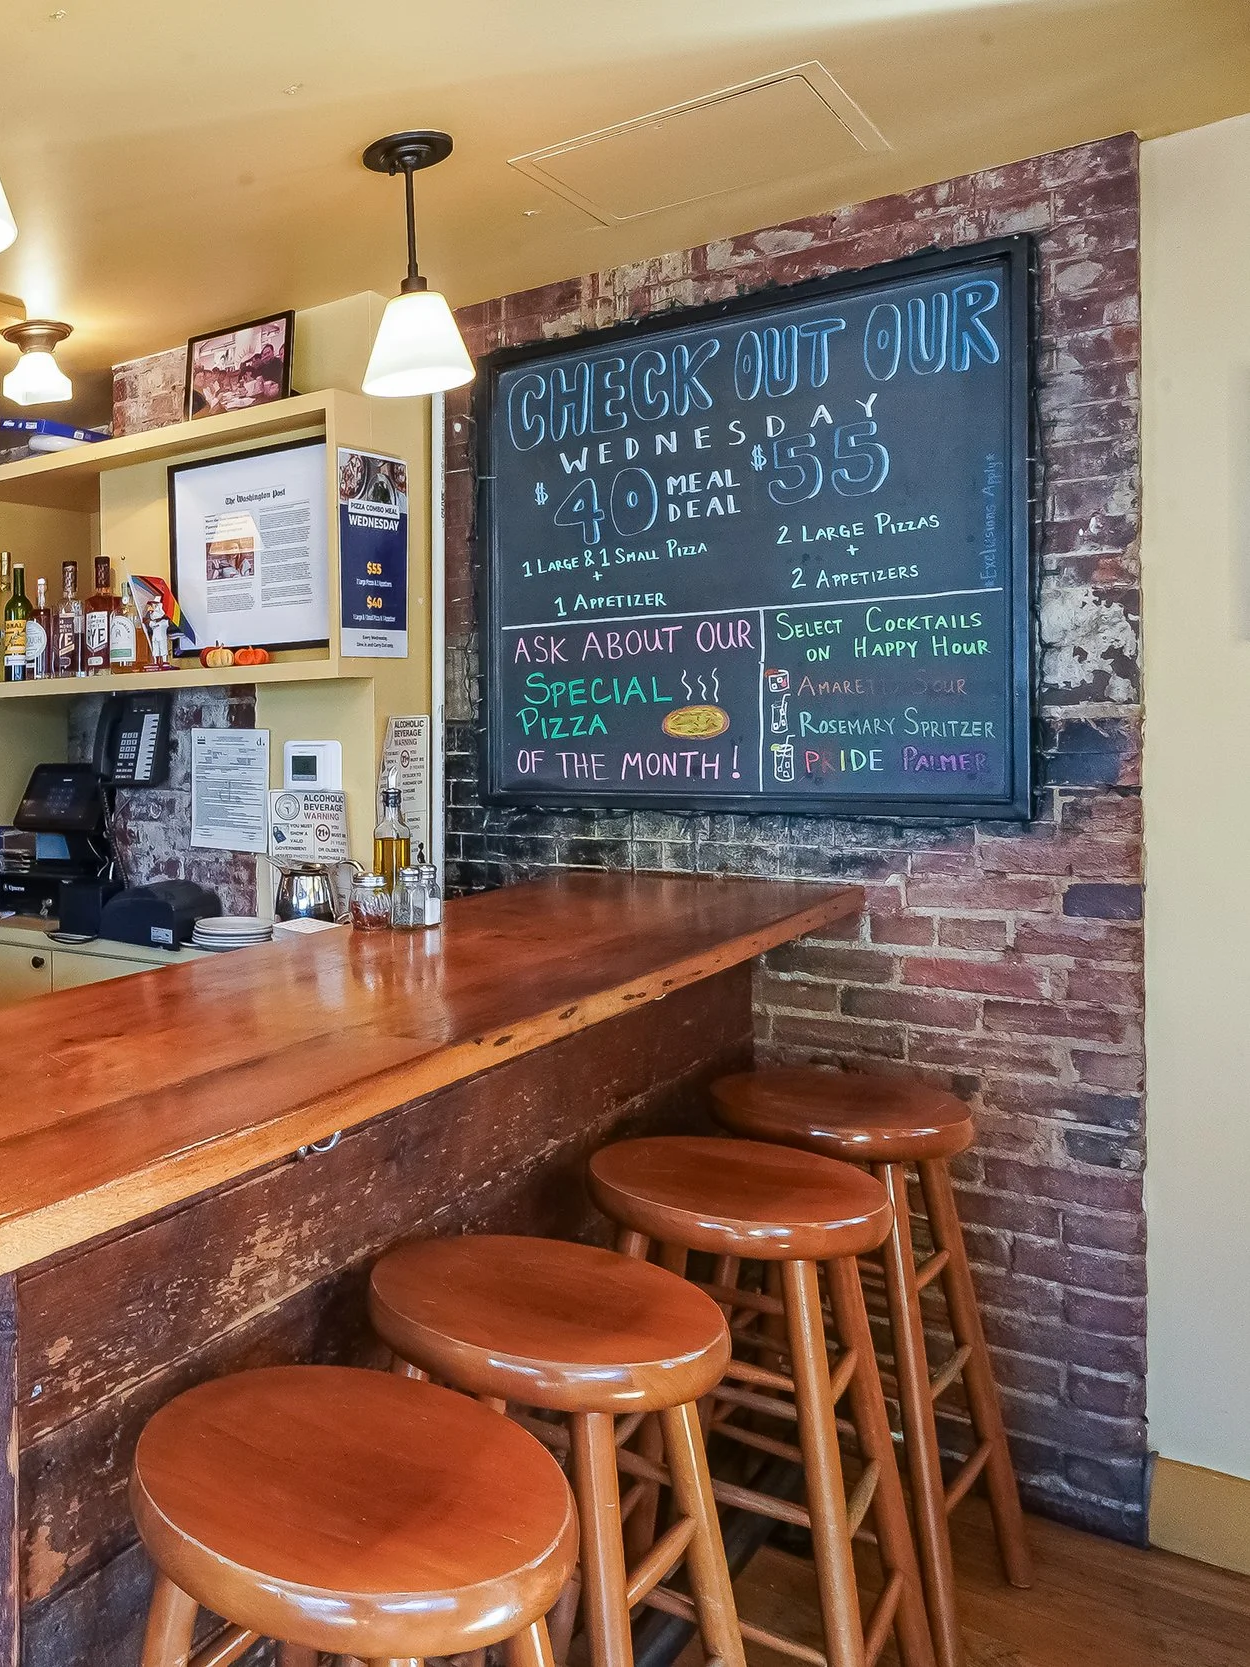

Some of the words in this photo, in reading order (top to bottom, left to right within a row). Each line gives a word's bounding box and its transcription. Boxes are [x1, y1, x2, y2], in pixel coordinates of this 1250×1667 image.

[508, 339, 720, 451] CHECK
[734, 318, 846, 401] OUT
[864, 280, 1000, 382] OUR
[559, 393, 878, 475] WEDNESDAY
[667, 469, 741, 496] MEAL
[225, 497, 235, 505] The
[236, 493, 271, 503] Washington
[272, 488, 286, 499] Post
[350, 501, 365, 511] PIZZA
[668, 494, 741, 522] DEAL
[348, 514, 400, 532] WEDNESDAY
[776, 525, 792, 544] 2
[584, 550, 595, 567] &
[600, 549, 610, 566] 1
[366, 561, 383, 575] $55
[791, 568, 806, 589] 2
[366, 595, 383, 609] $40
[554, 597, 567, 616] 1
[776, 612, 843, 641] SELECT
[865, 606, 982, 633] COCKTAILS
[514, 636, 569, 664] ASK
[582, 625, 682, 661] ABOUT
[696, 619, 755, 652] OUR
[854, 636, 918, 658] HAPPY
[931, 635, 991, 657] HOUR
[524, 672, 673, 708] SPECIAL
[394, 720, 425, 729] ALCOHOLIC
[516, 707, 608, 739] PIZZA
[800, 711, 896, 738] ROSEMARY
[903, 706, 996, 739] SPRITZER
[394, 729, 422, 738] BEVERAGE
[517, 750, 545, 774] OF
[555, 752, 609, 780] THE
[805, 749, 884, 773] PRIDE
[304, 794, 344, 803] ALCOHOLIC
[304, 804, 343, 812] BEVERAGE
[304, 812, 340, 820] WARNING
[318, 829, 328, 837] 21+
